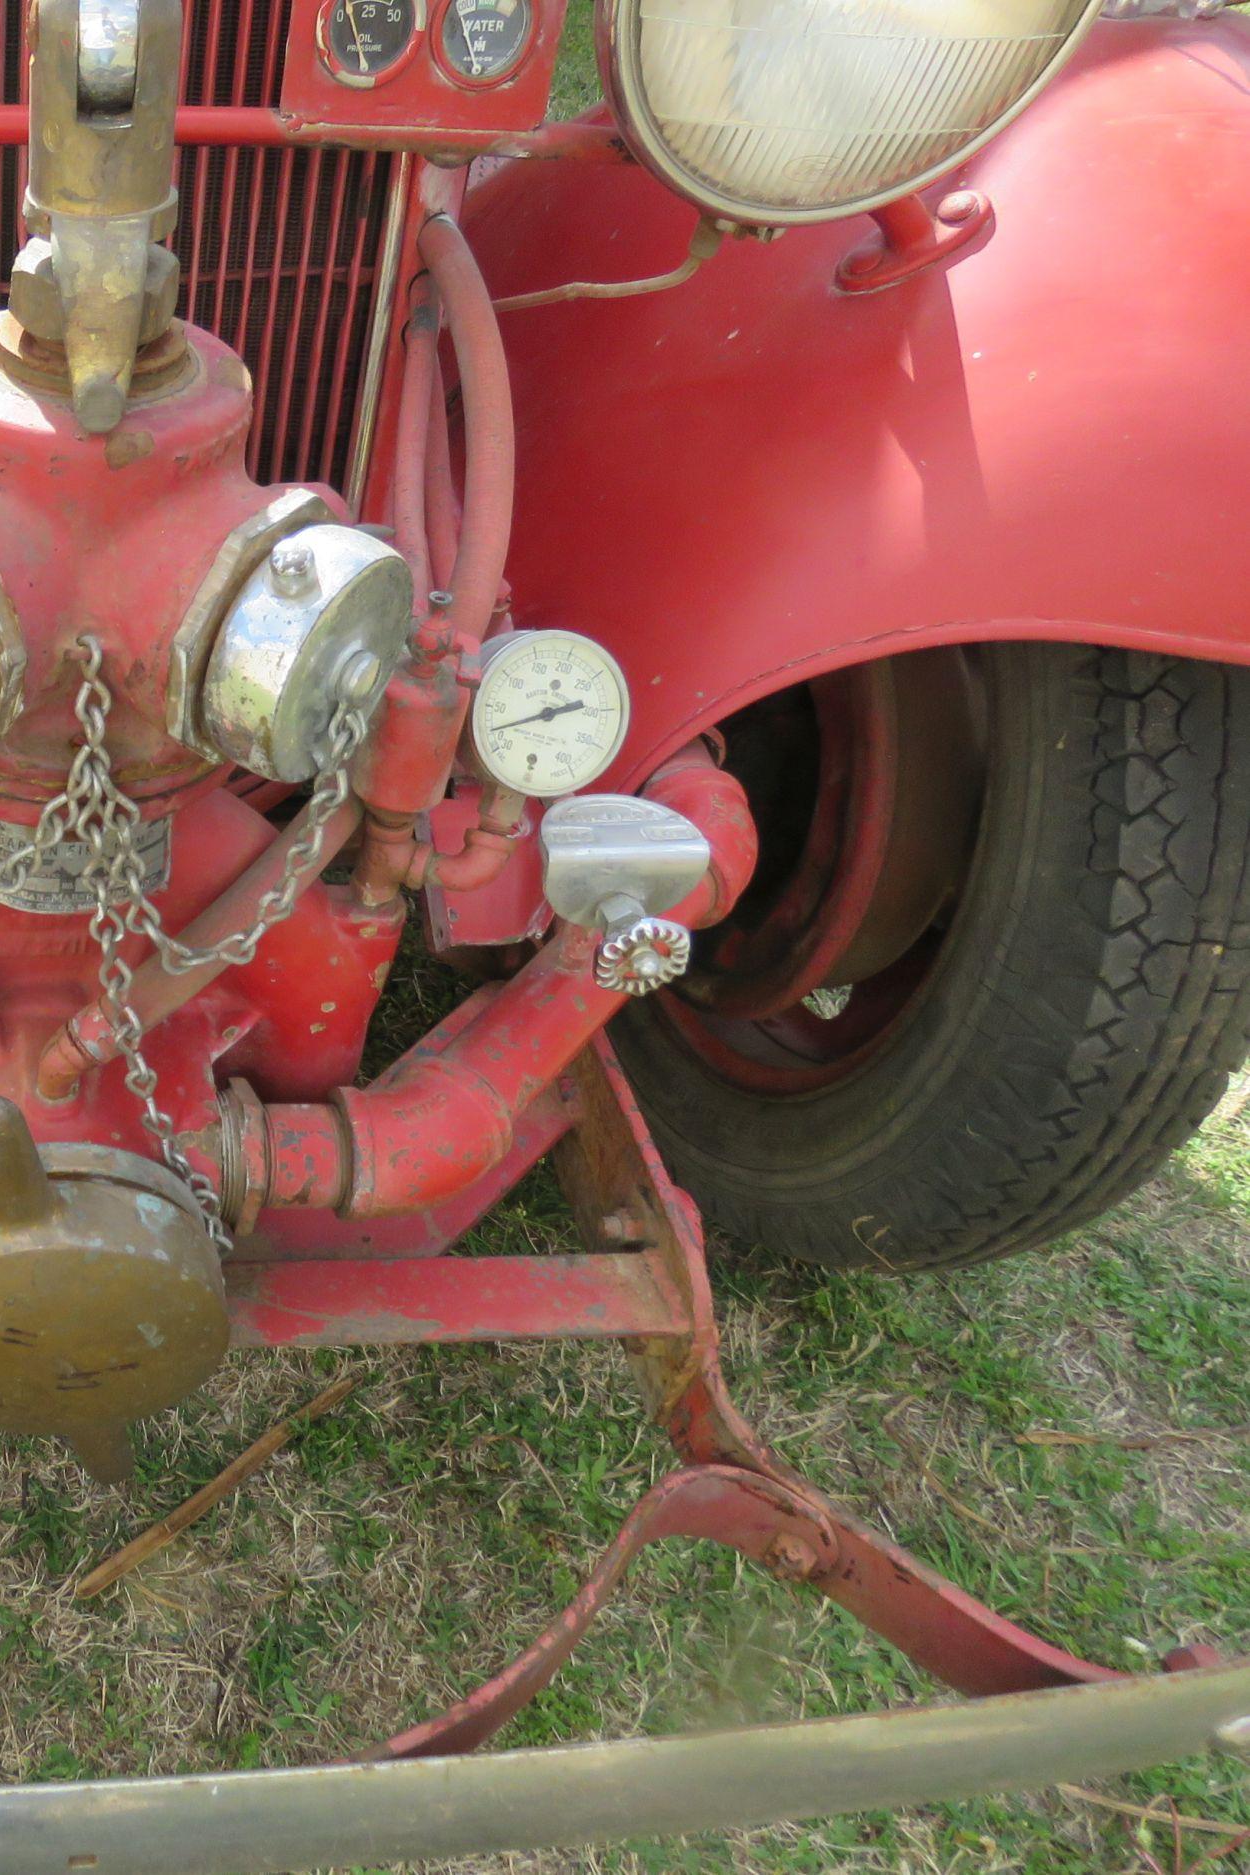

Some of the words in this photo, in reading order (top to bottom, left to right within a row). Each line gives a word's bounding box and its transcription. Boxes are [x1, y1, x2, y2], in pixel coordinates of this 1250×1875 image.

[336, 9, 344, 22] 0
[361, 4, 376, 18] 25
[386, 9, 402, 22] 50
[464, 20, 505, 32] WATER
[357, 33, 373, 43] OIL
[531, 662, 547, 675] 150
[554, 661, 572, 674] 200
[508, 677, 523, 690] 100
[574, 678, 592, 691] 250
[494, 702, 506, 714] 50
[582, 706, 599, 717] 300
[497, 731, 504, 740] 0
[575, 732, 592, 744] 350
[501, 738, 513, 750] 30
[554, 751, 572, 764] 400
